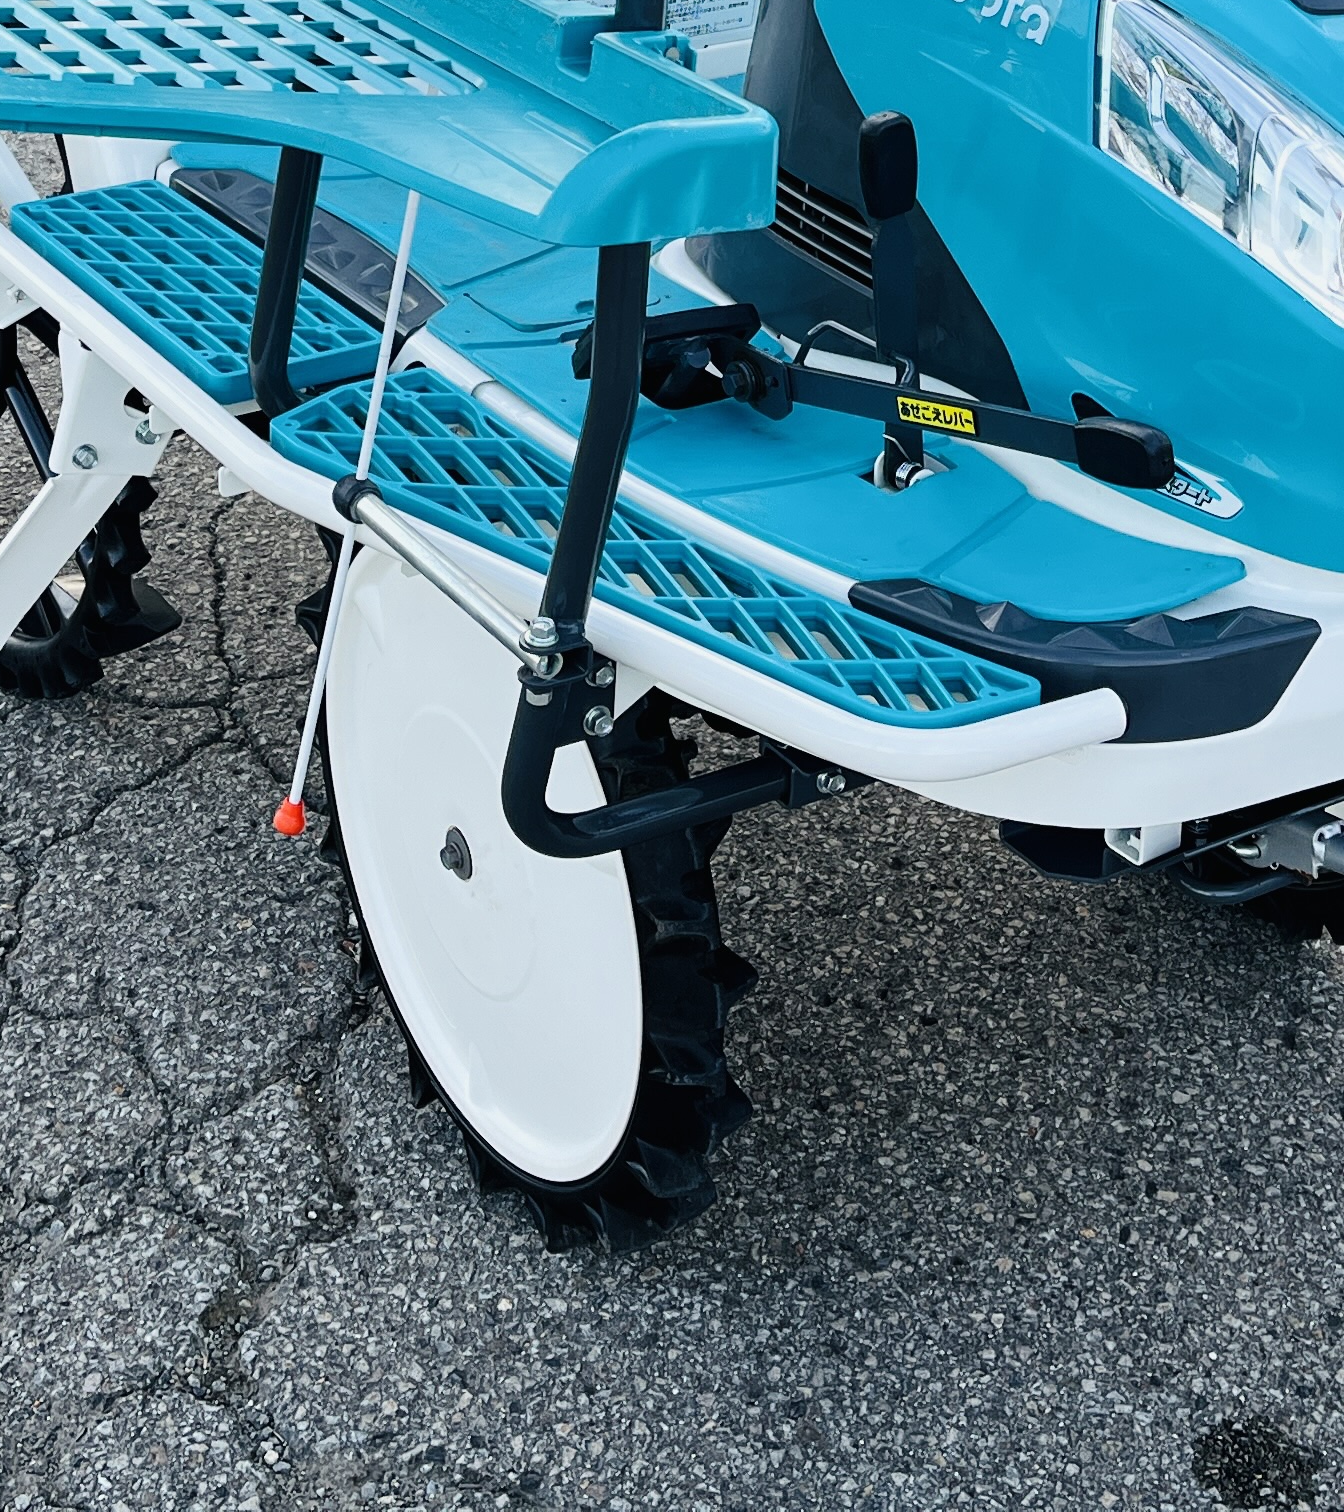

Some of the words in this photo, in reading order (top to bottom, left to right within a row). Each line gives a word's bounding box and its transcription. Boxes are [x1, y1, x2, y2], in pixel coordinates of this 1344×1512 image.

[899, 400, 973, 428] あぜごえレバー
